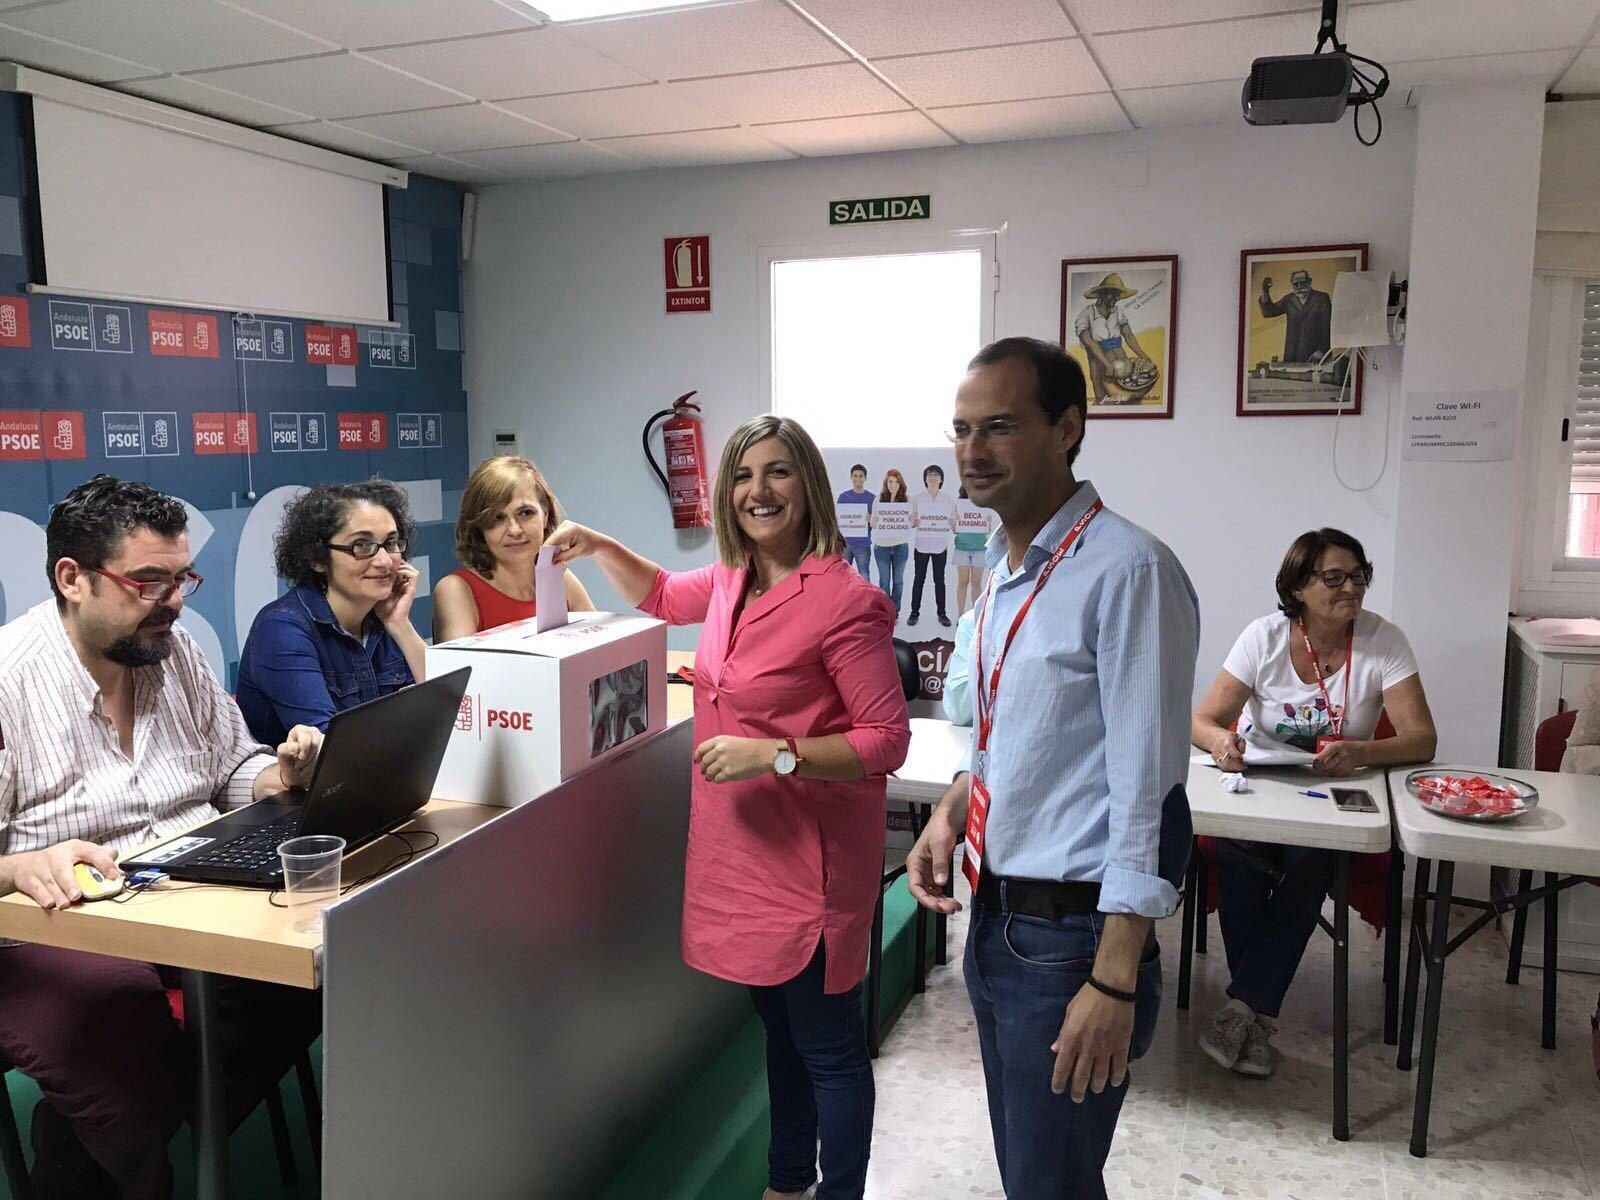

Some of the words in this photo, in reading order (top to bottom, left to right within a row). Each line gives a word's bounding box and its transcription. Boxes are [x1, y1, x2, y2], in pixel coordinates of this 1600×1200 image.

[834, 198, 925, 222] SALIDA
[671, 296, 706, 306] EXTINTOR
[54, 324, 90, 340] PSOE
[152, 331, 184, 347] PSOE
[236, 337, 262, 352] PSOE
[307, 342, 332, 356] PSOE
[371, 347, 392, 360] PSOE
[1, 433, 41, 450] PSOE
[108, 433, 140, 448] PSOE
[196, 431, 225, 446] PSOE
[273, 430, 298, 443] PSOE
[340, 430, 362, 442] PSOE
[400, 429, 419, 441] PSOE
[963, 512, 982, 520] BECA
[1074, 506, 1097, 532] PSOE
[1043, 547, 1065, 577] PSOE
[487, 709, 533, 731] PSOE
